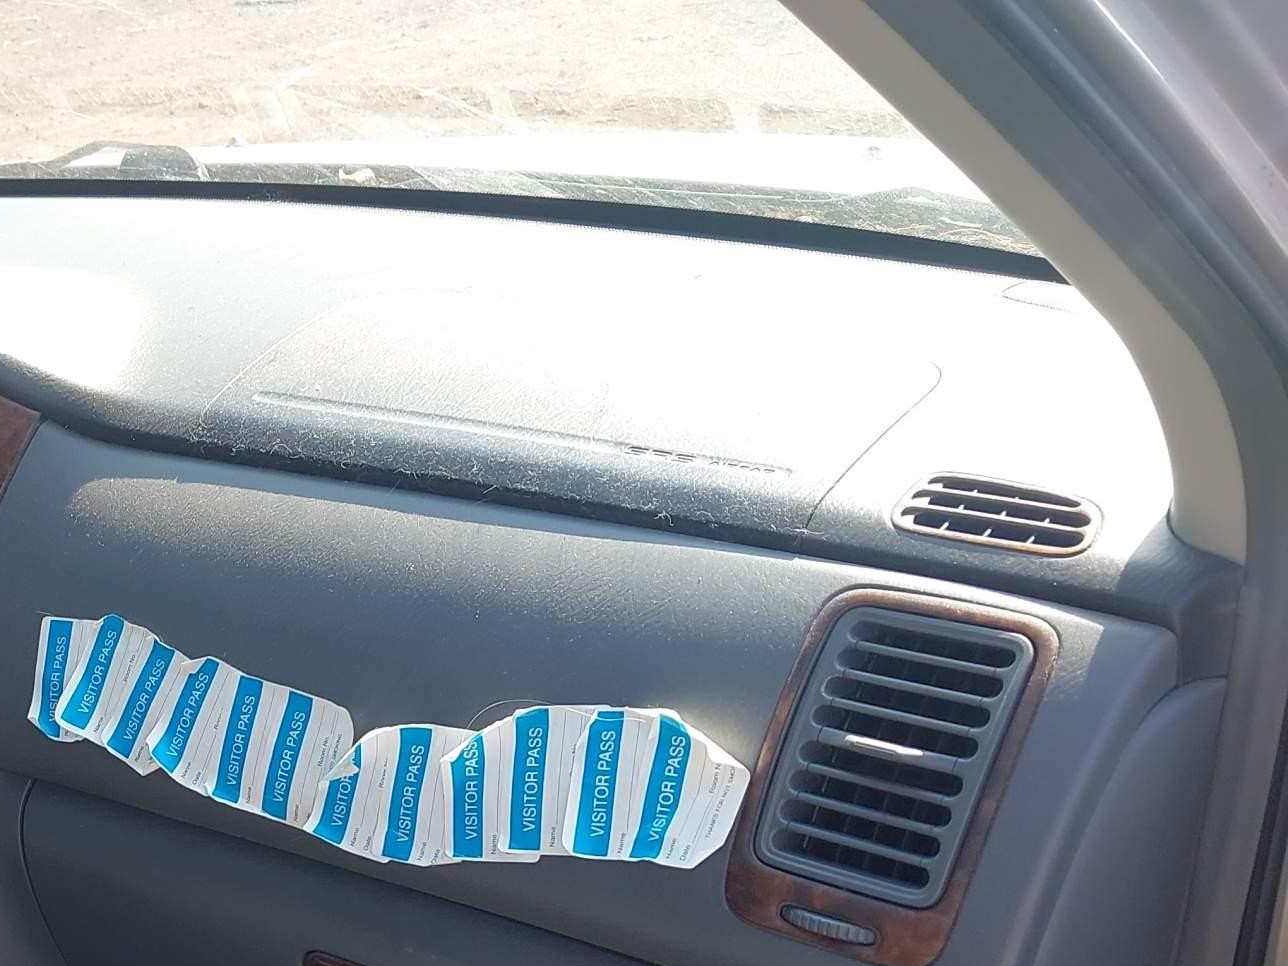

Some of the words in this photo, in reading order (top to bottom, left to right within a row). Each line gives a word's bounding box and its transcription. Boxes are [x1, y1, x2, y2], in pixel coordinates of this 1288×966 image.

[53, 636, 67, 669] PASS
[78, 665, 105, 714] VISITOR
[100, 630, 117, 663] PASS
[123, 691, 150, 741] VISITOR
[145, 658, 165, 691] PASS
[166, 707, 194, 757] VISITOR
[188, 672, 209, 706] PASS
[227, 733, 246, 786] VISITOR
[238, 695, 256, 730] PASS
[272, 749, 294, 802] VISITOR
[286, 711, 306, 747] PASS
[527, 727, 543, 766] PASS
[598, 730, 616, 770] PASS
[396, 786, 416, 842] VISITOR
[406, 745, 424, 782] PASS
[465, 780, 478, 840] VISITOR
[522, 772, 538, 832] VISITOR
[590, 776, 610, 837] VISITOR
[648, 781, 676, 841] VISITOR
[665, 736, 686, 777] PASS
